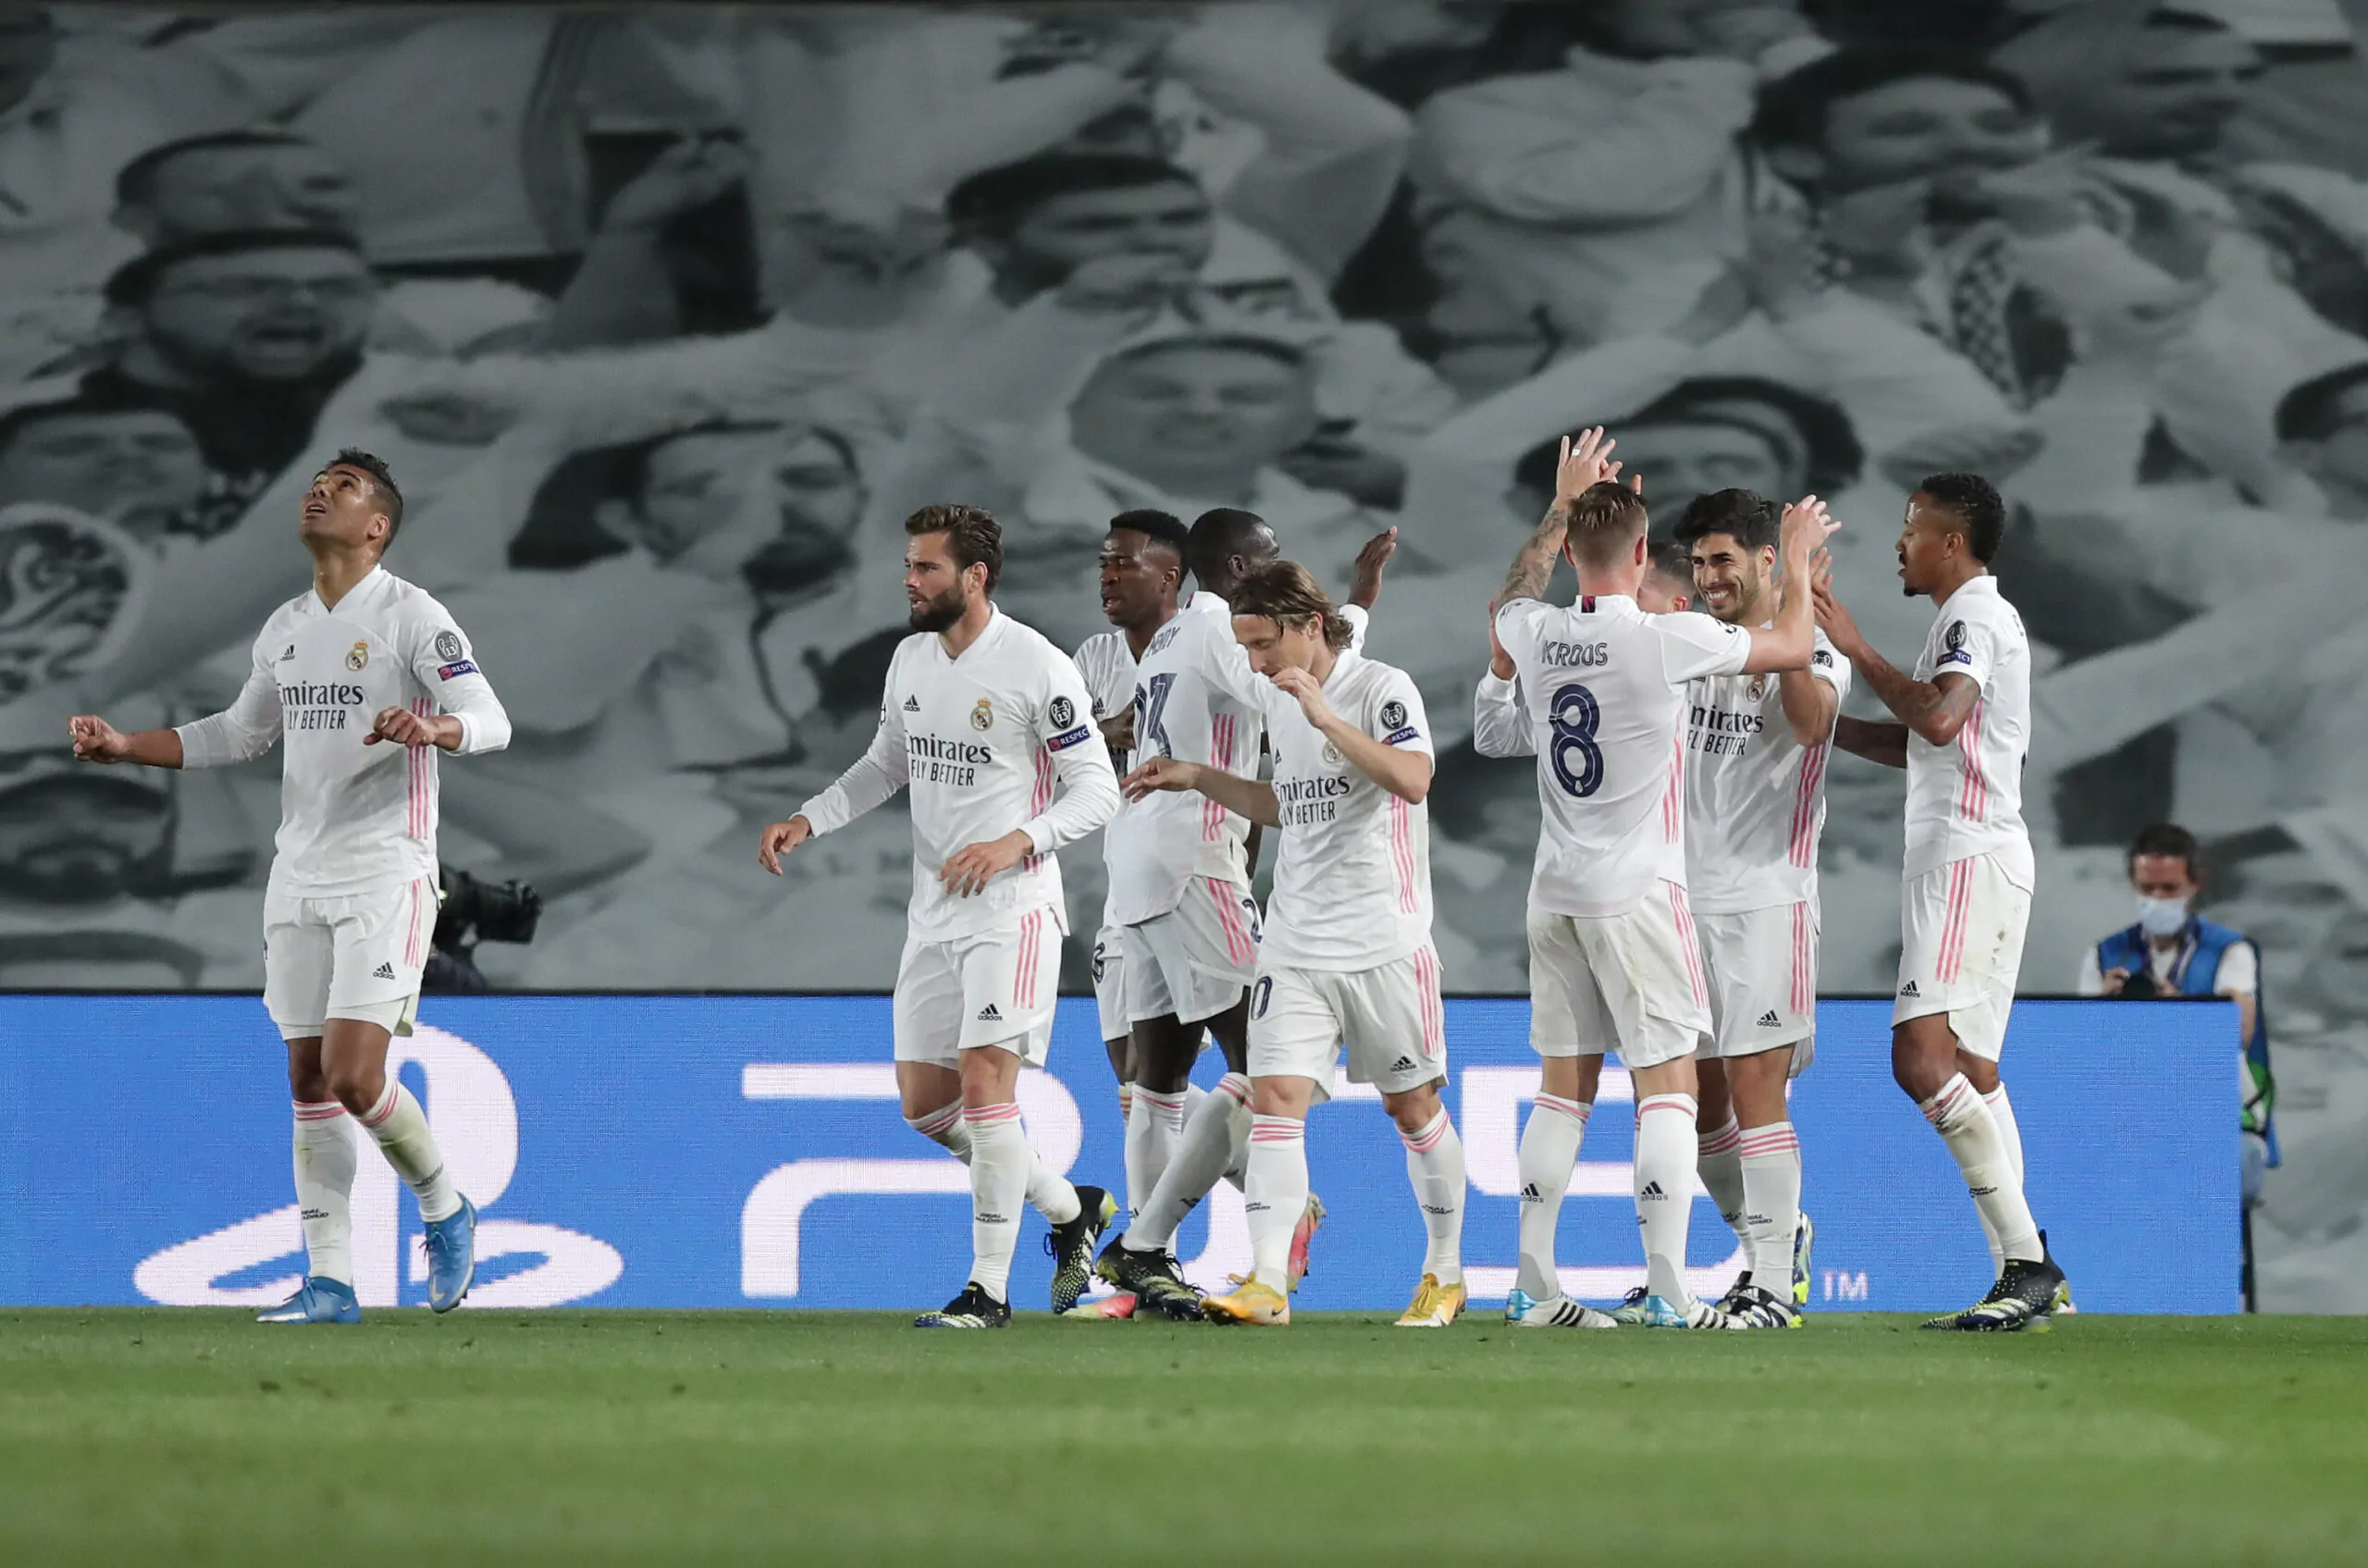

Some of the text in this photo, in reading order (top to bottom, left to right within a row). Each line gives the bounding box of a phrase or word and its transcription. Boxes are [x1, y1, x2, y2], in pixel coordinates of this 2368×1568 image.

[445, 646, 457, 657] 13
[1541, 640, 1609, 666] KROOS
[277, 679, 364, 706] mirates
[286, 710, 347, 730] LY BETTER
[1688, 700, 1765, 734] mirates
[904, 729, 992, 764] mirates
[1059, 728, 1089, 745] RESPEC
[1548, 684, 1604, 797] 8
[910, 759, 976, 786] FLY BETTER
[1280, 800, 1336, 826] LY BETTER
[1757, 1019, 1782, 1029] adidas
